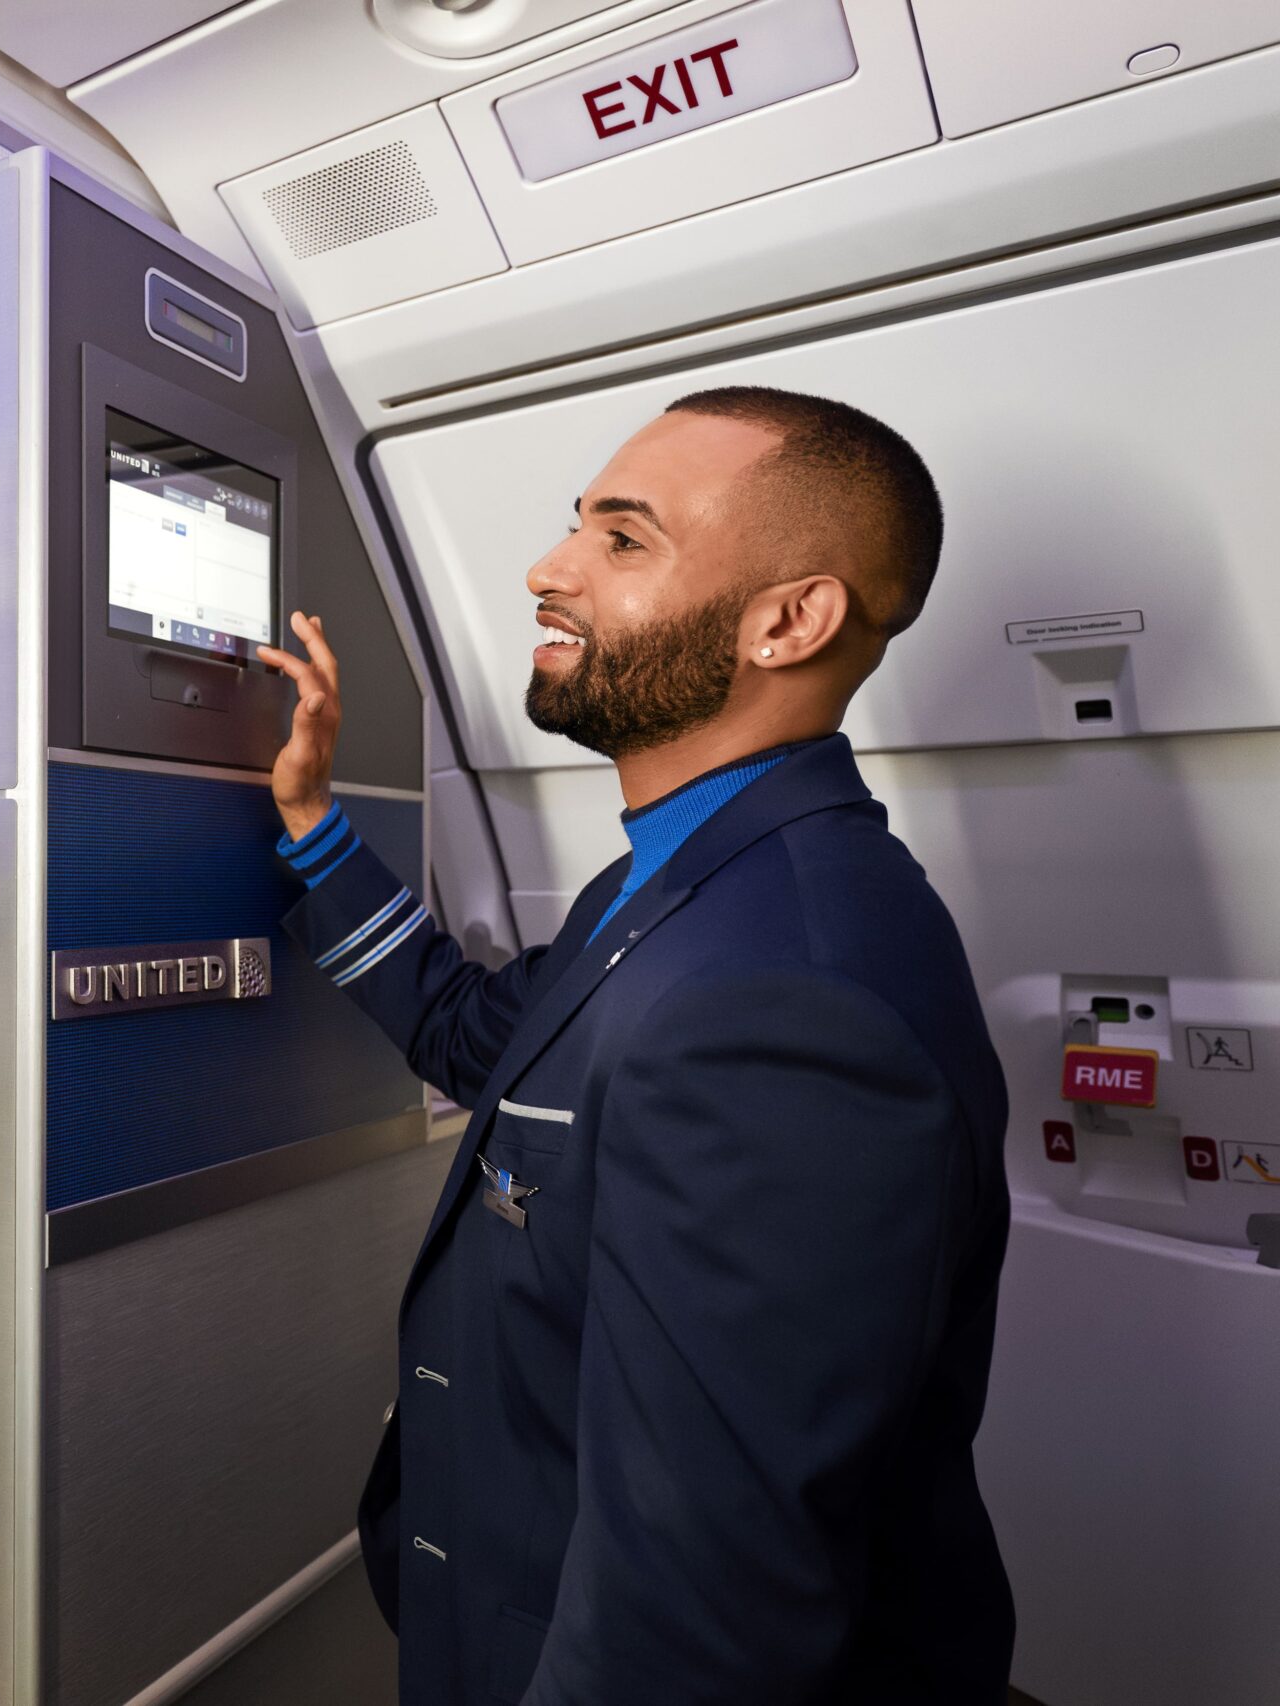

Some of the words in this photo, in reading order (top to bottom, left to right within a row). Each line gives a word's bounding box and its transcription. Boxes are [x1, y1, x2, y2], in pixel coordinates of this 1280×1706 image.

[582, 38, 739, 139] EXIT
[110, 449, 141, 469] UNITED
[1080, 620, 1122, 630] indication
[69, 955, 227, 1005] UNITED
[1075, 1066, 1144, 1090] RME
[1051, 1133, 1070, 1151] A
[1191, 1151, 1212, 1168] D
